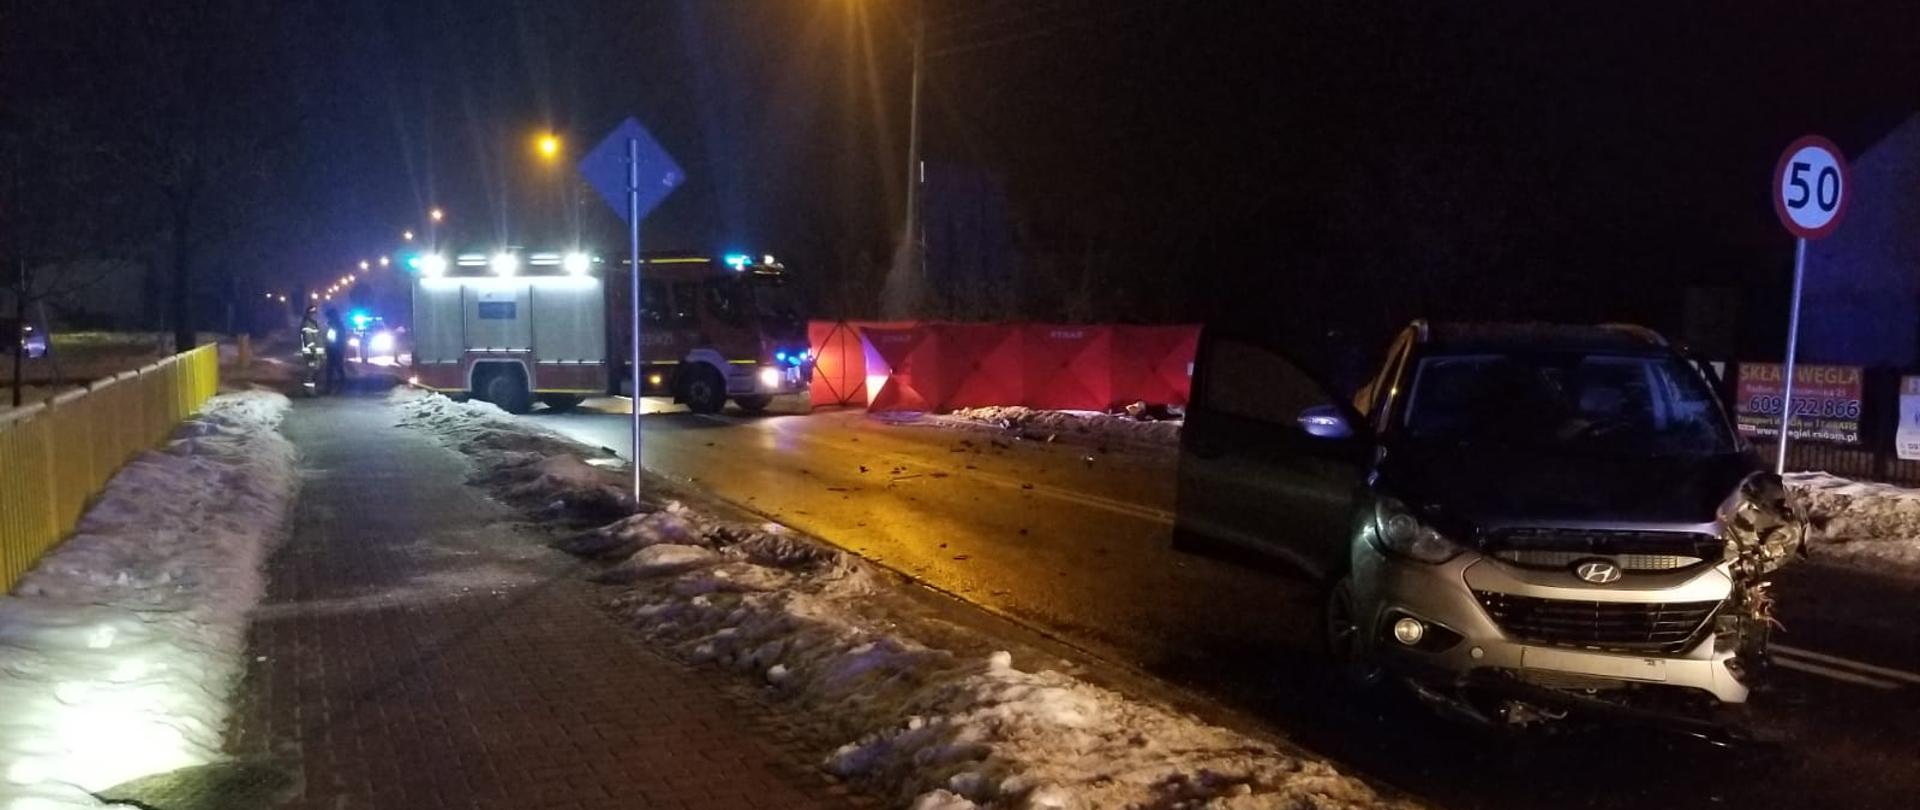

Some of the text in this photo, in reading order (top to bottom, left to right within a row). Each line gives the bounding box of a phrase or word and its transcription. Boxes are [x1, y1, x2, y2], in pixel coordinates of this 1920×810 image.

[1787, 161, 1839, 212] 50
[1739, 364, 1789, 382] SKŁA
[1750, 396, 1782, 415] 609
[1823, 399, 1861, 418] 866
